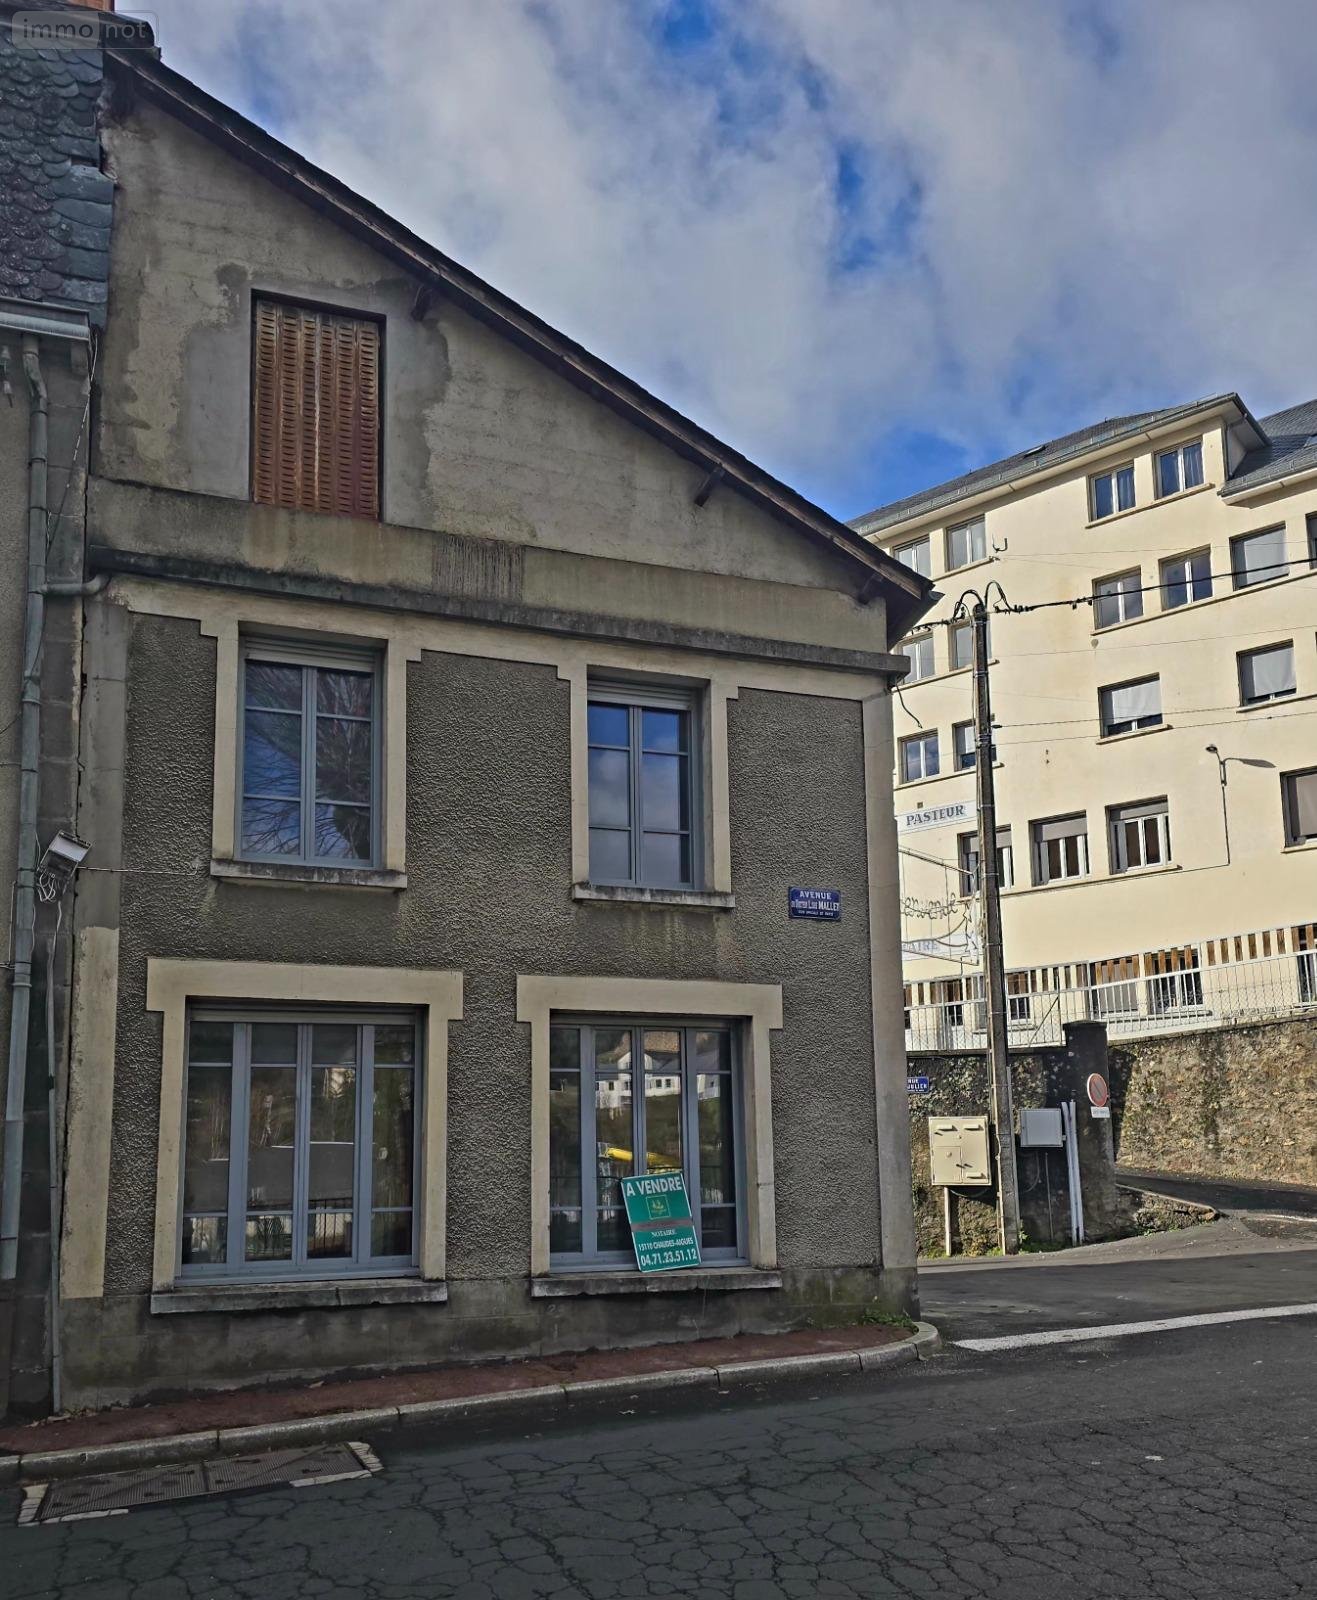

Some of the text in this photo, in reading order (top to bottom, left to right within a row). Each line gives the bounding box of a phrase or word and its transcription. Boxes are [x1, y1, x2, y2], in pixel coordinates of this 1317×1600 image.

[906, 804, 965, 826] PASTEUR
[800, 890, 832, 900] AVENUE
[635, 1176, 682, 1195] VENDRE
[640, 1248, 698, 1267] 04.71.23.51.12
